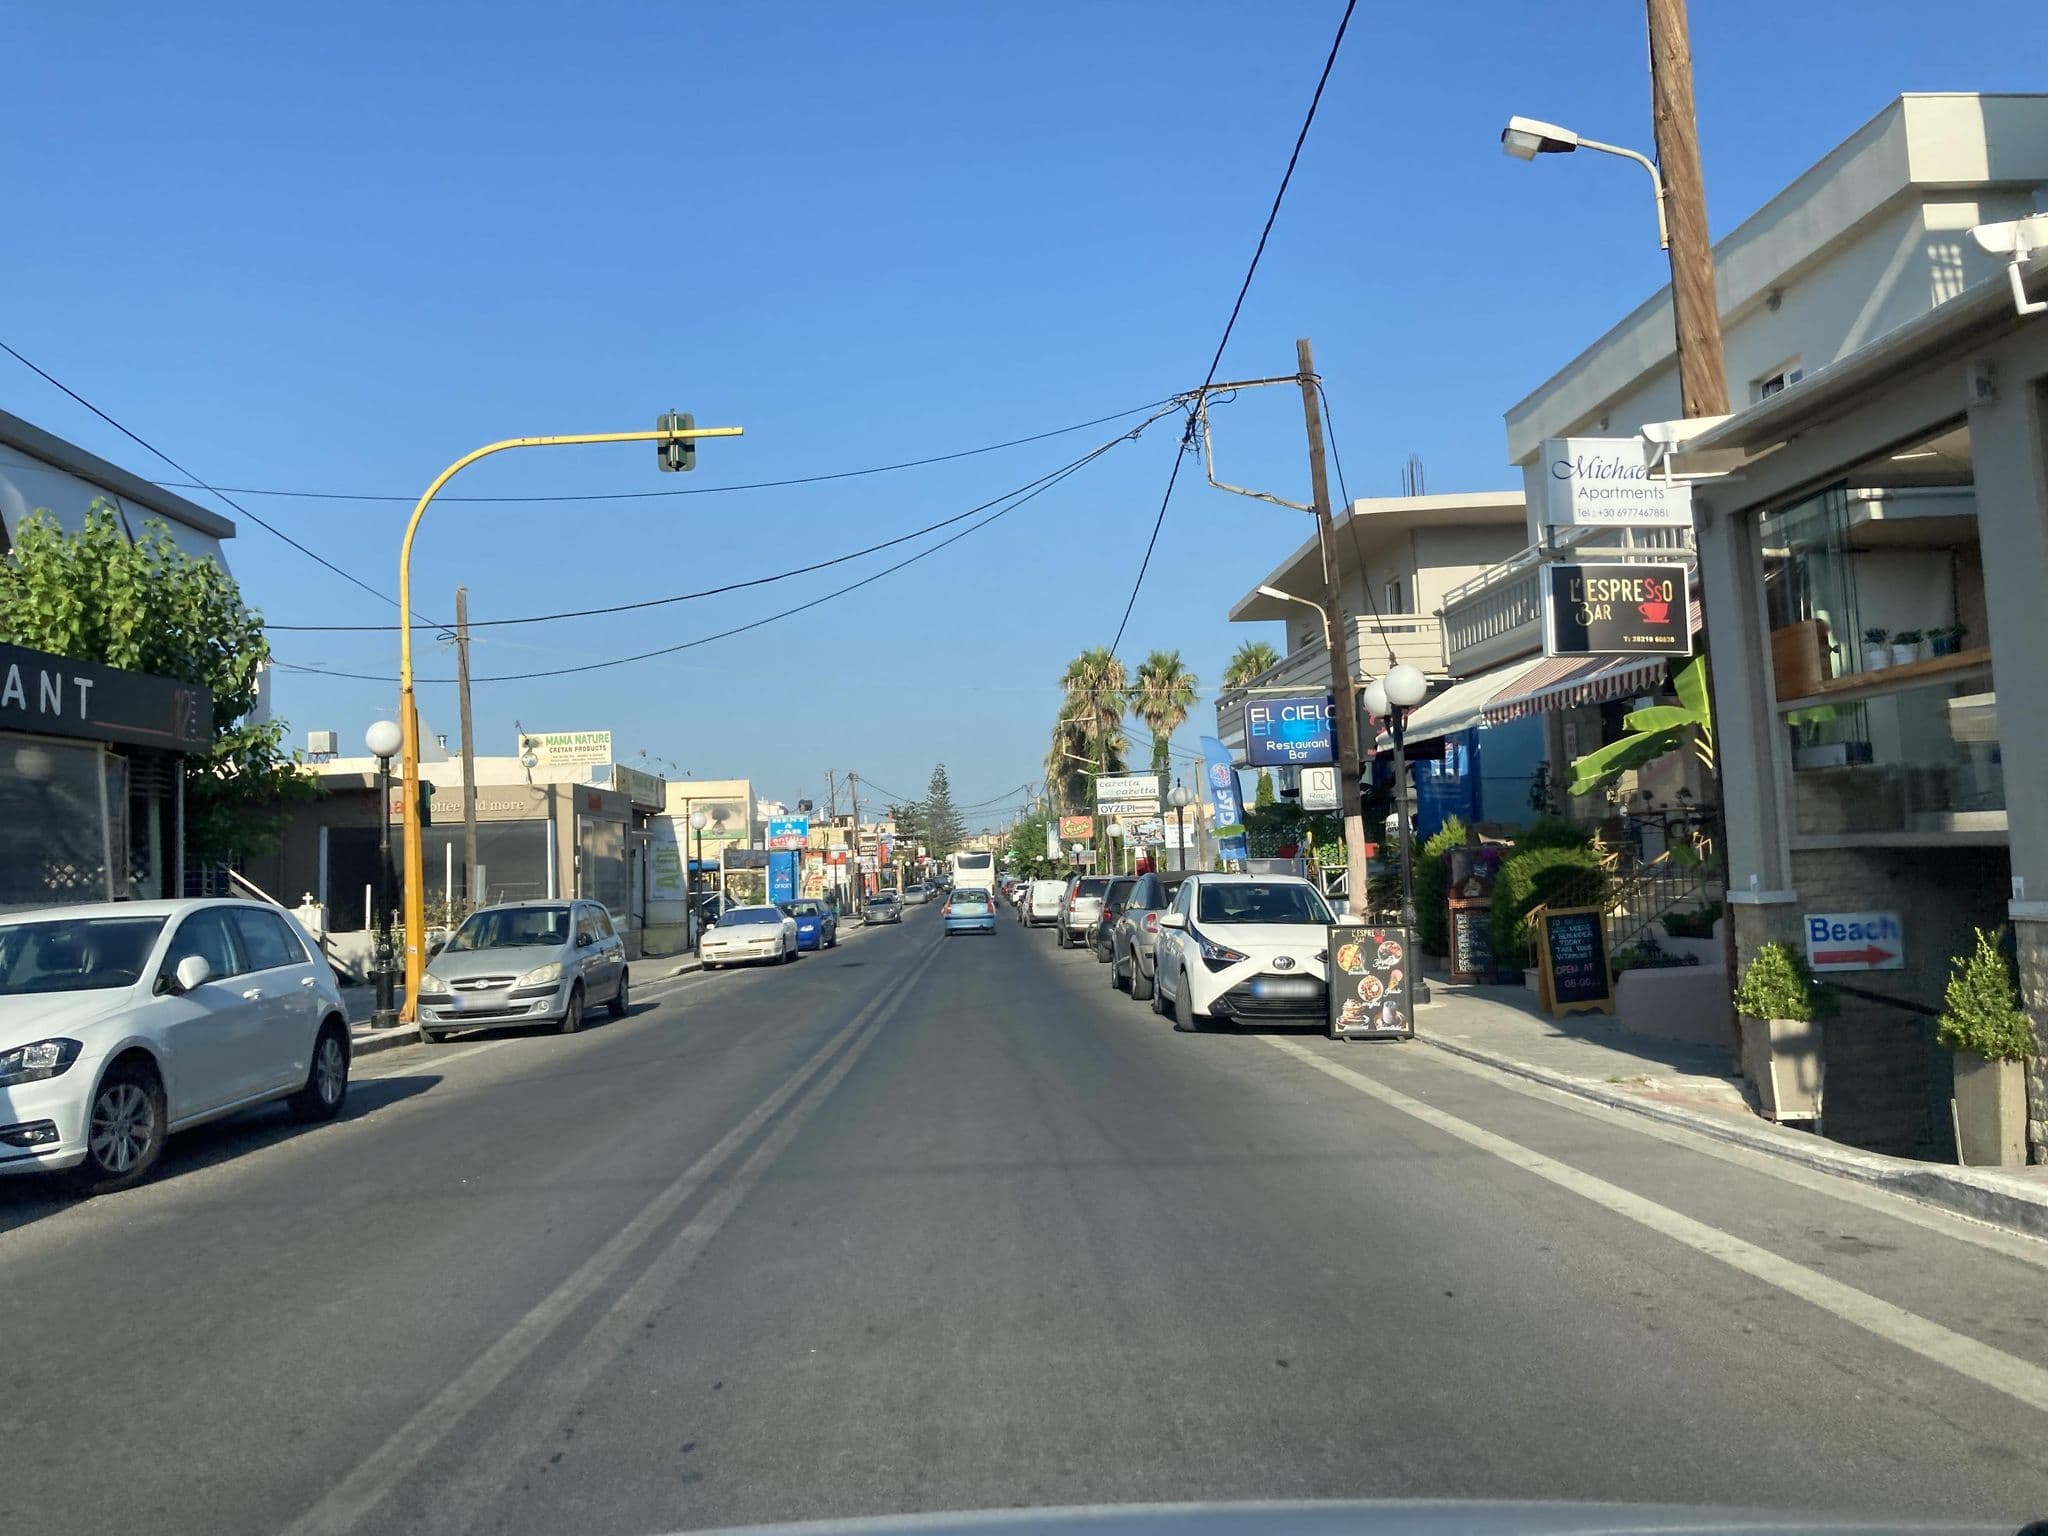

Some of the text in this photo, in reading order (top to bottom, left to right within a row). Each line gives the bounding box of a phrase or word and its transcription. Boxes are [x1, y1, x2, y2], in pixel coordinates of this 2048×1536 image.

[1552, 456, 1647, 479] Michae
[1578, 486, 1665, 501] Apartments
[1, 663, 94, 720] ANT
[1250, 708, 1275, 722] EL
[545, 733, 610, 746] MAMA NATURE
[1266, 739, 1330, 751] Restaurant
[1289, 749, 1308, 760] Bar
[431, 800, 461, 813] offee
[490, 800, 524, 812] more
[1809, 917, 1899, 942] Beach
